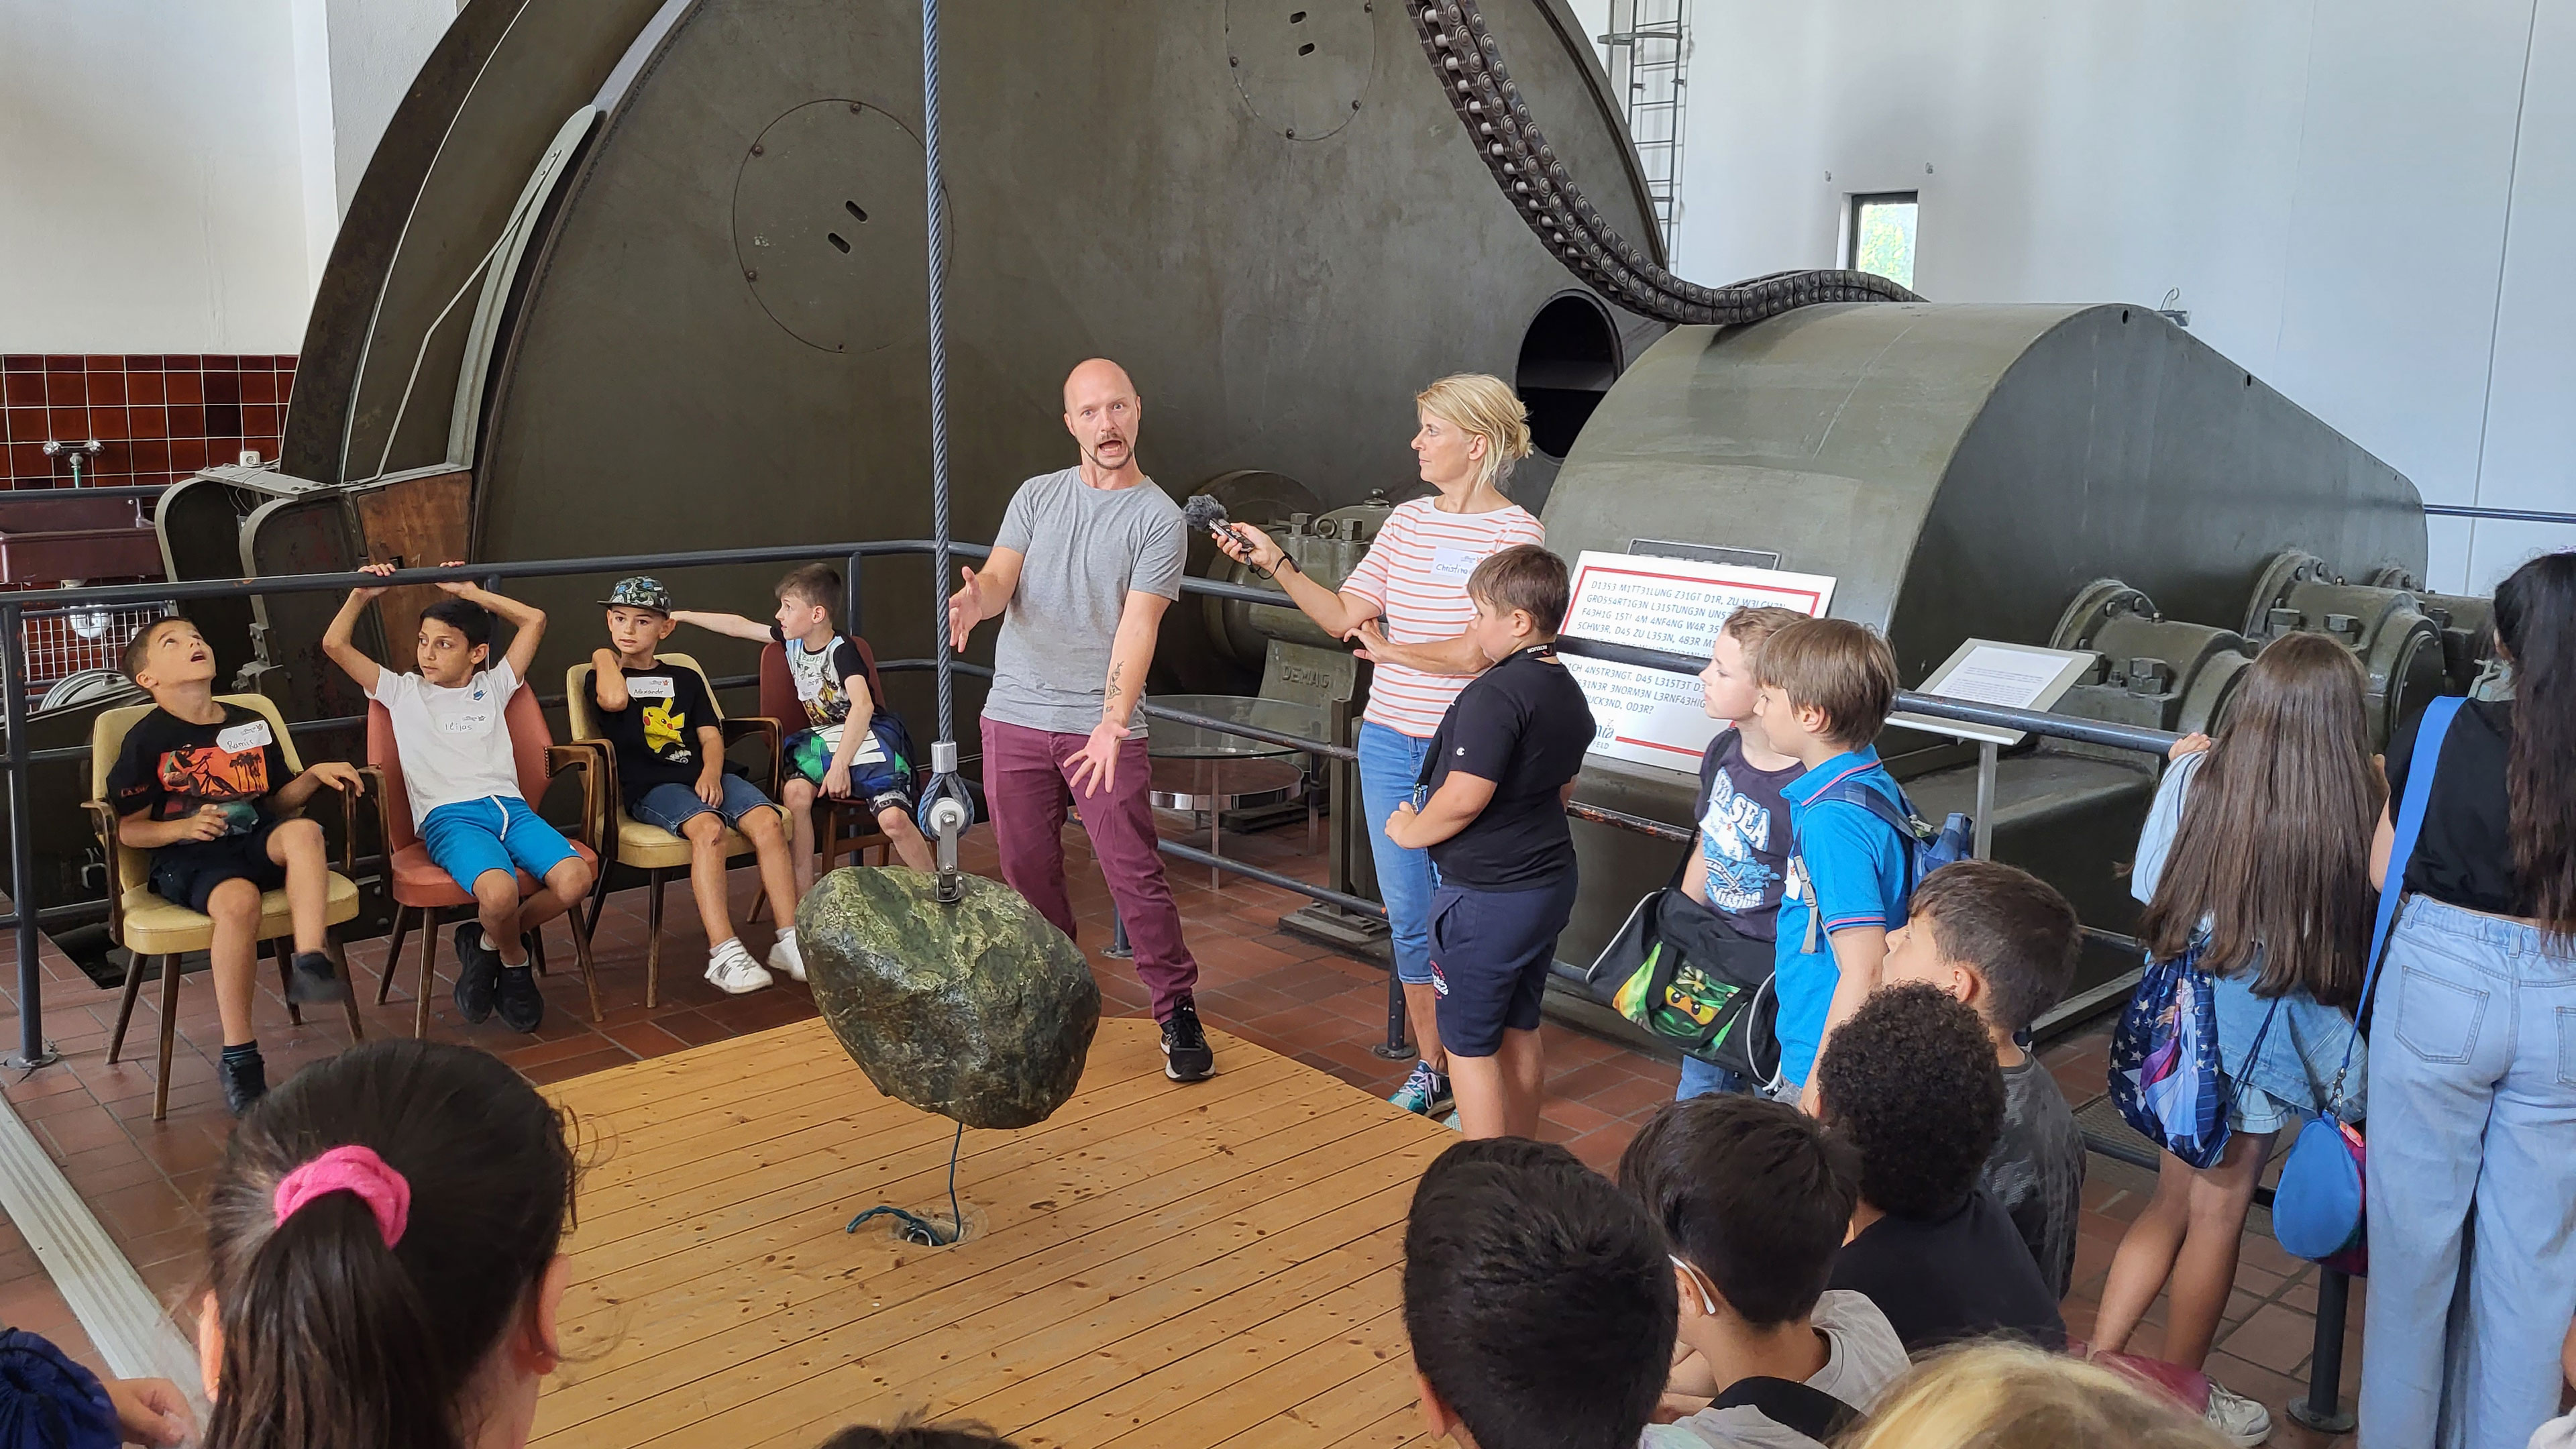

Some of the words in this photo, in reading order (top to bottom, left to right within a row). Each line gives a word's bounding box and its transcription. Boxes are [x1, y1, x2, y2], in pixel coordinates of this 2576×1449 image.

[1727, 596, 1739, 606] ZU
[1650, 617, 1684, 629] 4NF4NG
[1686, 621, 1705, 632] W4R
[1633, 629, 1645, 638] ZU
